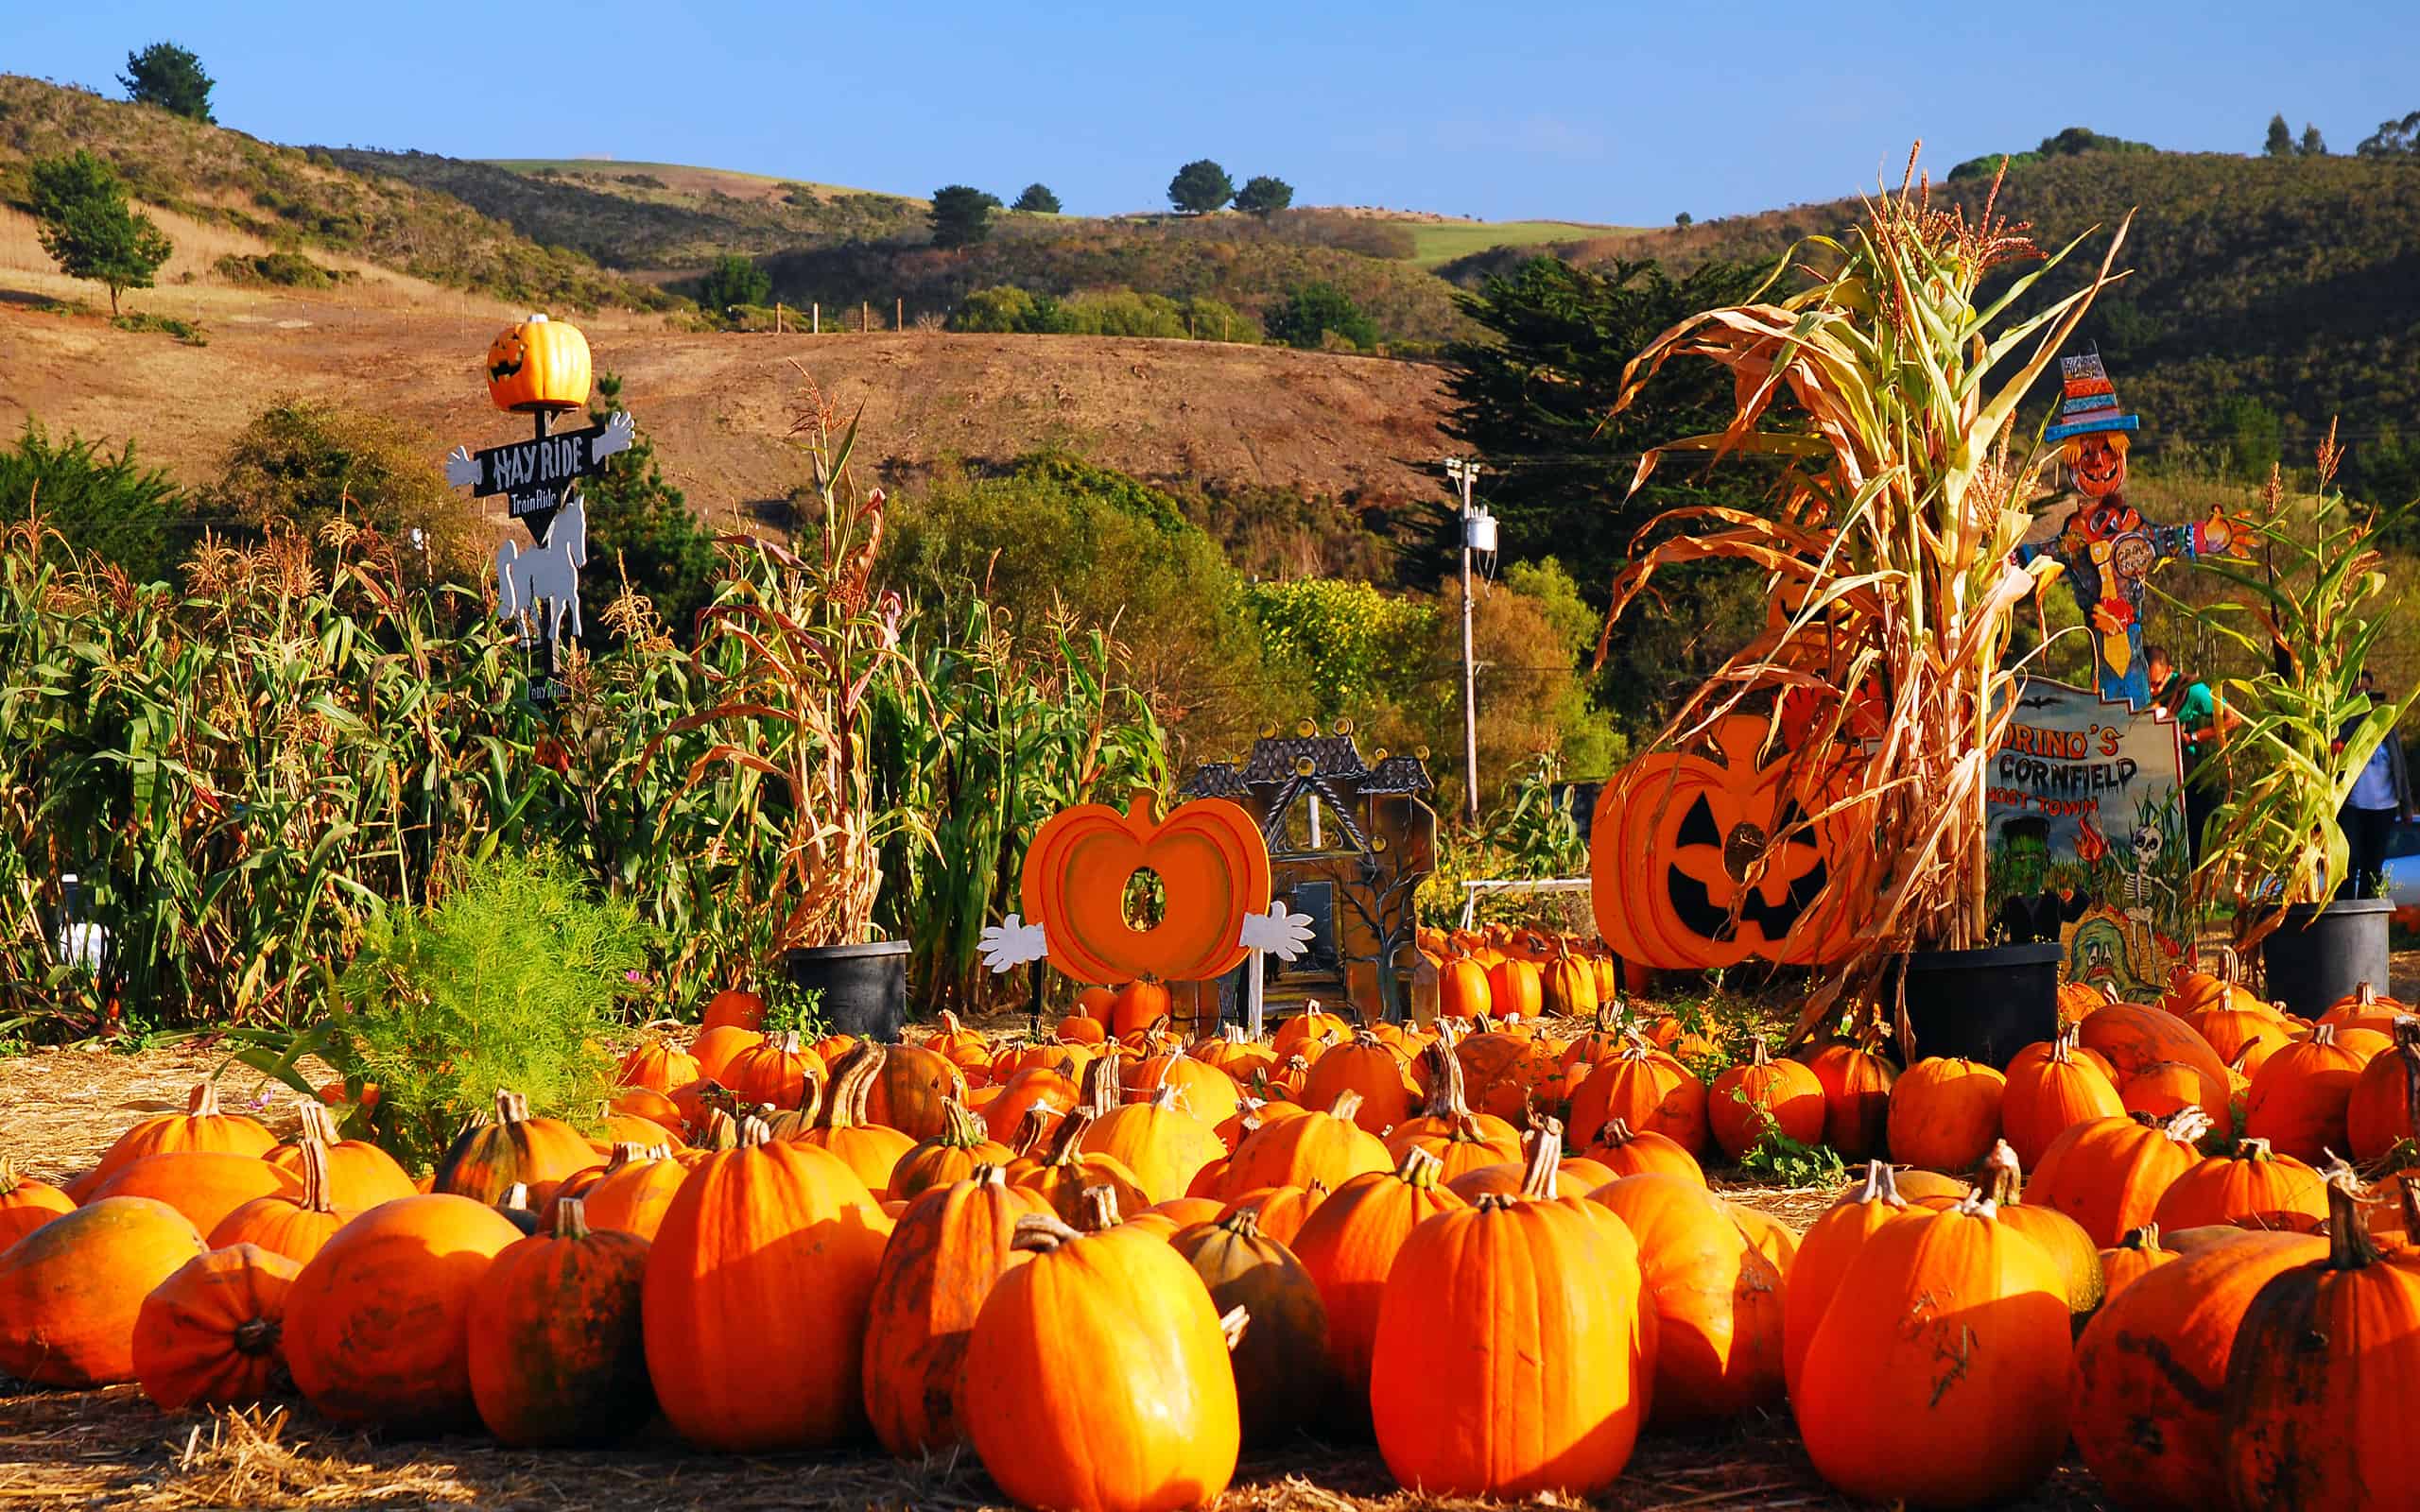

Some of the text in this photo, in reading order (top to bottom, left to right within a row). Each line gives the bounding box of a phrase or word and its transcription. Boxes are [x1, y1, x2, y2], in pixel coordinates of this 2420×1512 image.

[510, 491, 535, 515] Train
[1999, 723, 2124, 760] ORINO'S
[1999, 752, 2137, 793] CORNFIELD
[1986, 786, 2100, 816] HOST TOWN
